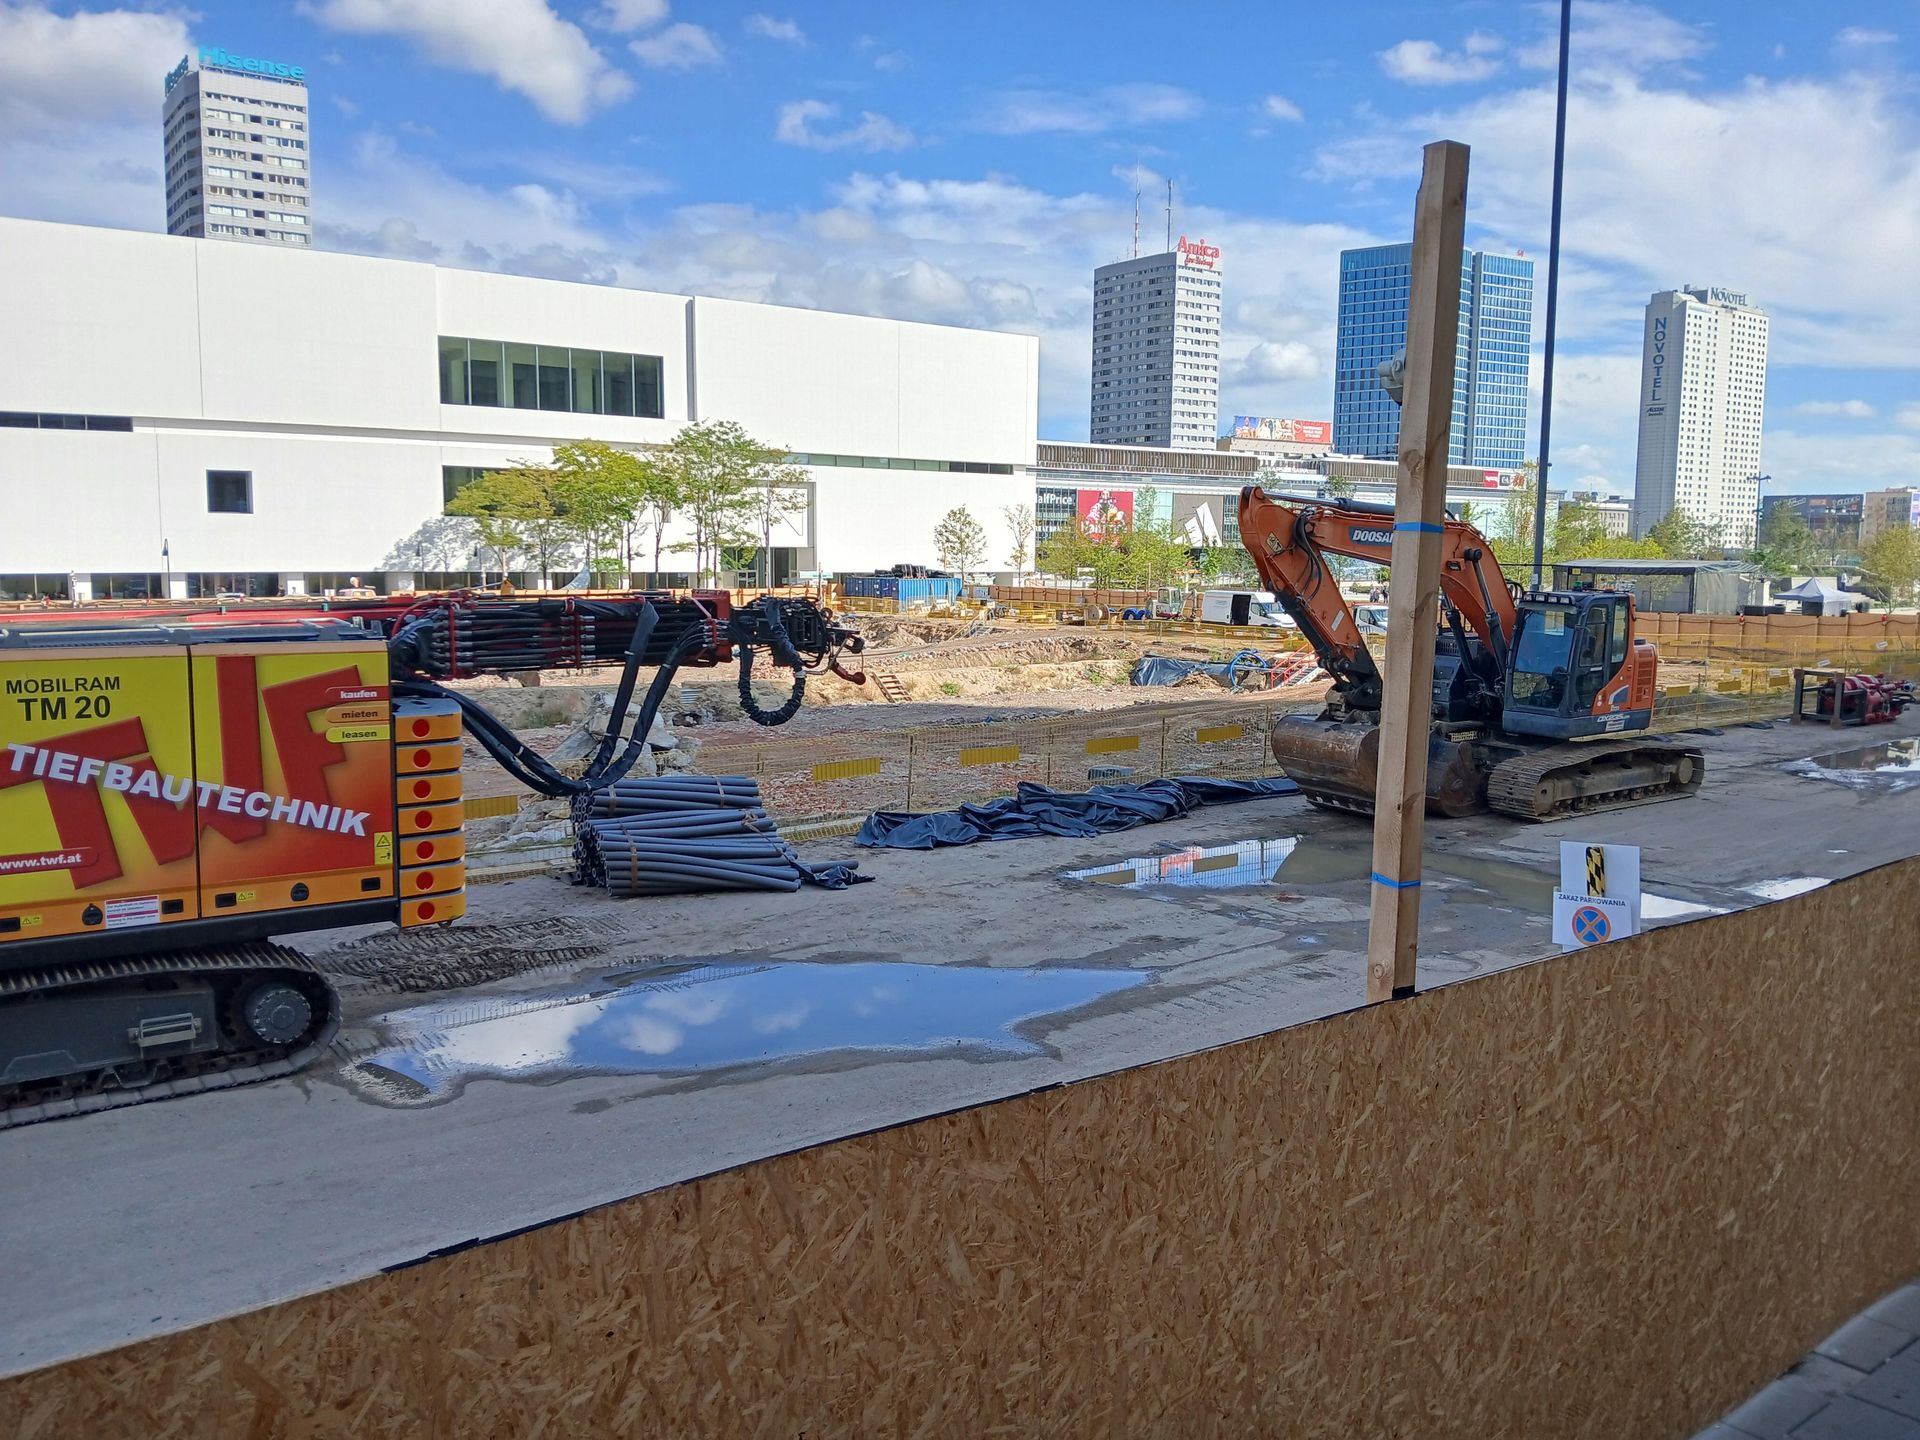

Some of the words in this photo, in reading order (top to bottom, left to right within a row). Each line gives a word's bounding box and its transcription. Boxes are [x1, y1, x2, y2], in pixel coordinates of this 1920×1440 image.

[198, 44, 306, 80] Hisense
[1177, 235, 1220, 258] Amica
[1711, 287, 1748, 306] NOVOTEL
[1652, 317, 1667, 401] NOVOTEL
[6, 676, 120, 694] MOBILRAM
[340, 689, 377, 699] kaufen
[17, 697, 67, 721] TM
[74, 695, 111, 719] 20
[341, 710, 378, 719] mieten
[341, 730, 377, 739] leasen
[7, 742, 370, 836] TIEFBAUTECHNIK
[0, 853, 82, 870] www.twf.at
[1558, 893, 1579, 902] ZAKAZ
[1579, 896, 1626, 907] PARKOWANIA
